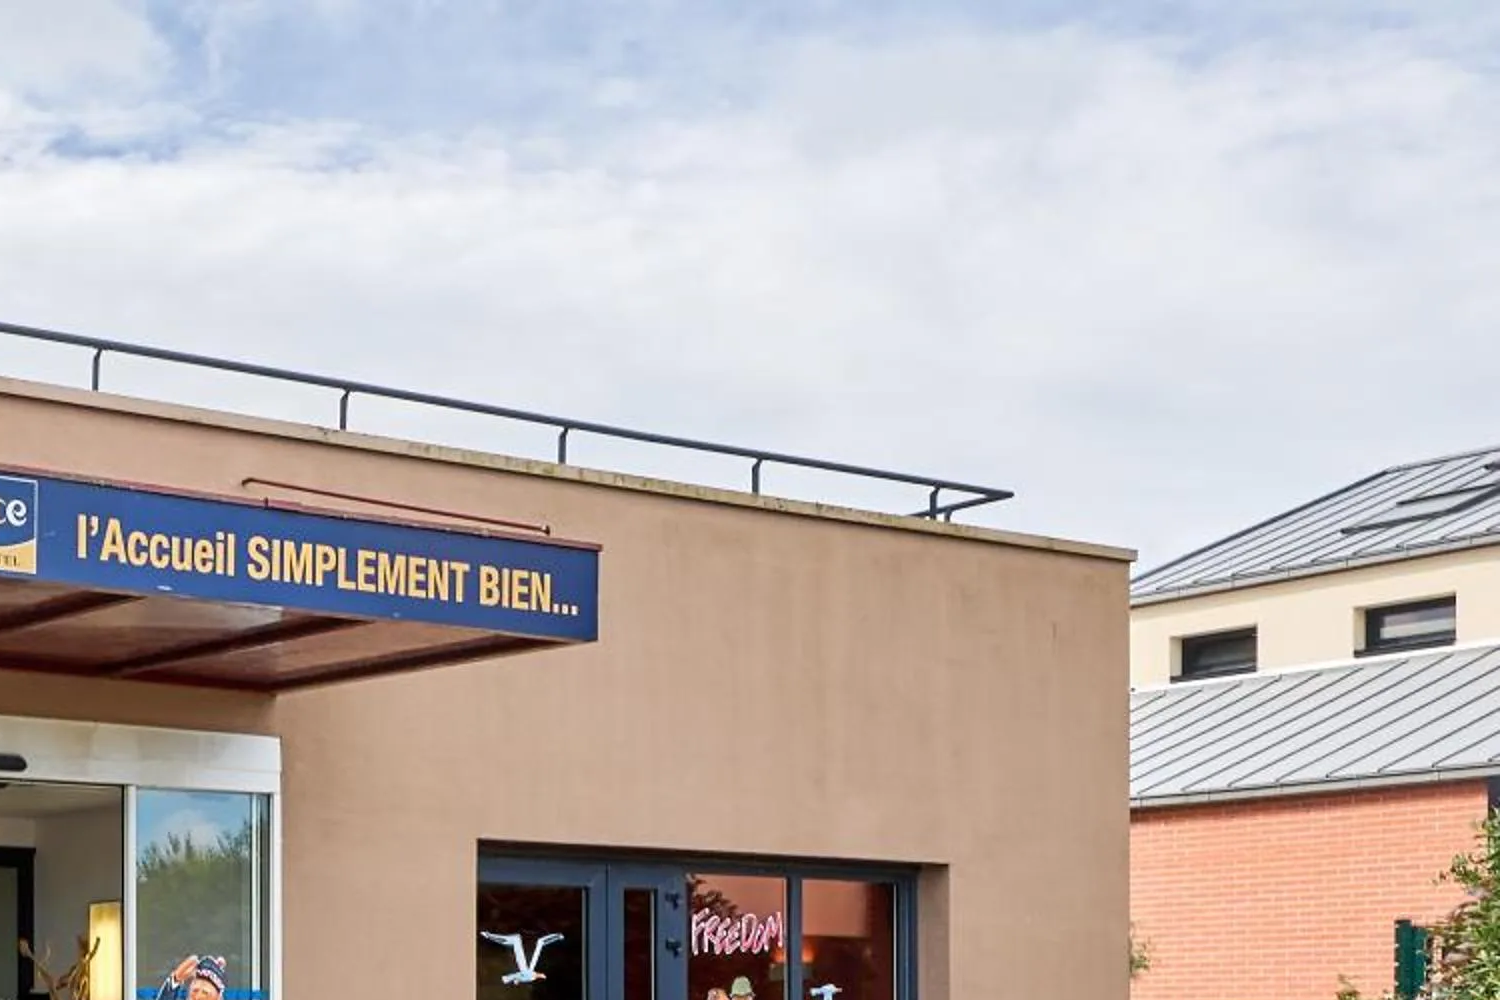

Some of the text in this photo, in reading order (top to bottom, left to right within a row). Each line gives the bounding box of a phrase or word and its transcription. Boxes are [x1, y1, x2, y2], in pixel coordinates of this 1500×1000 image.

[77, 513, 580, 615] l’Accueil SIMPLEMENT BIEN...
[691, 908, 783, 955] FREEDOM
